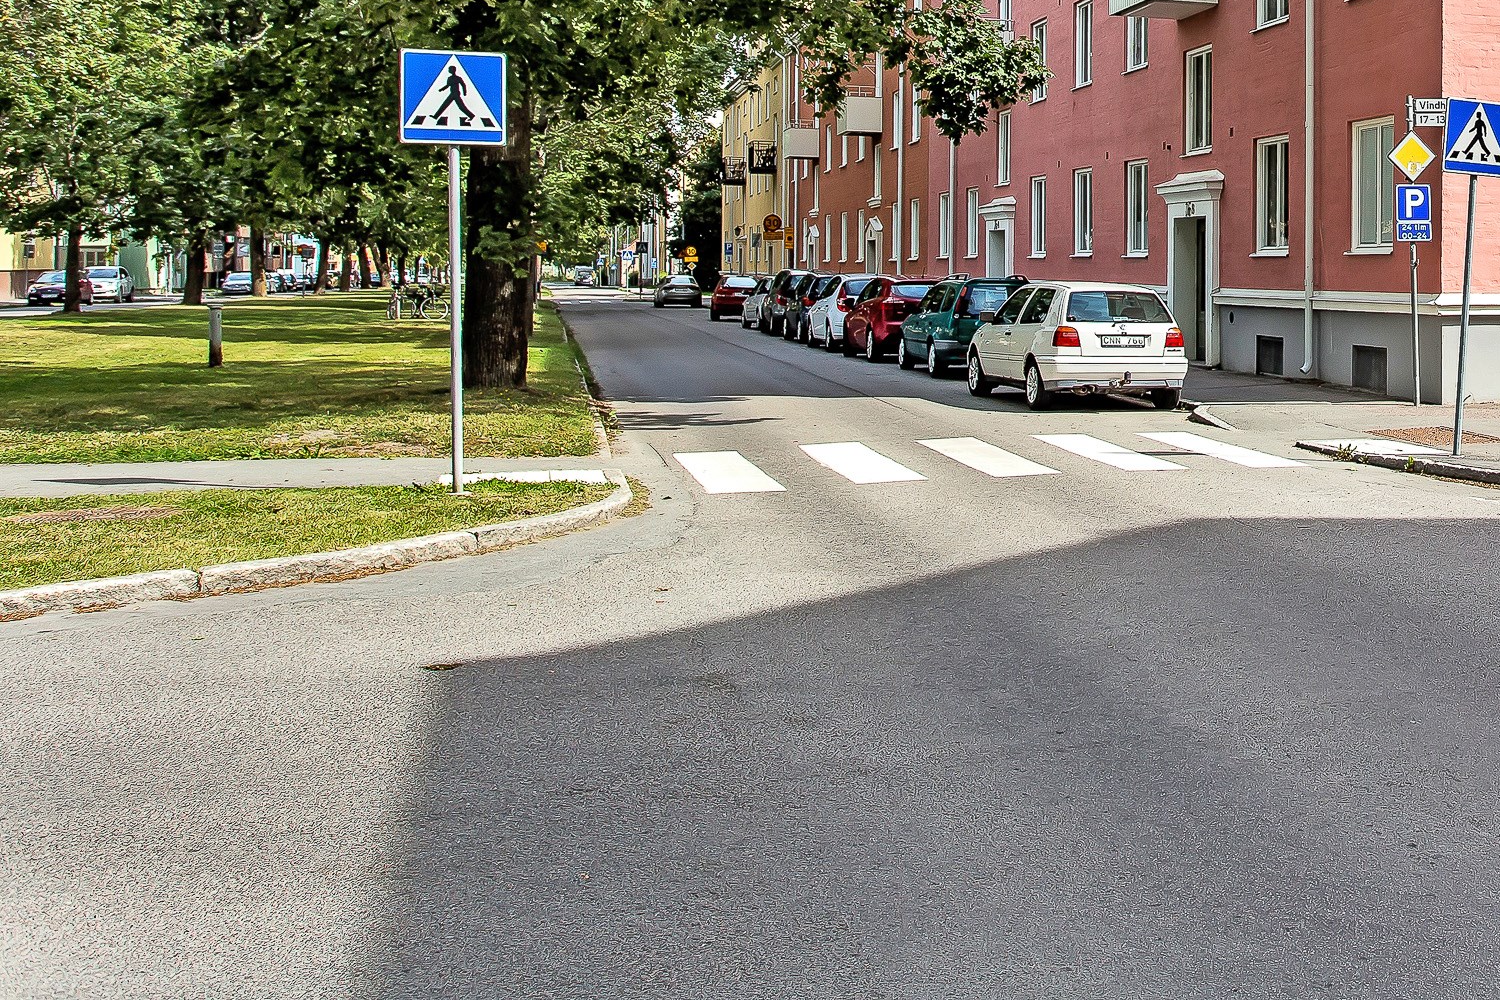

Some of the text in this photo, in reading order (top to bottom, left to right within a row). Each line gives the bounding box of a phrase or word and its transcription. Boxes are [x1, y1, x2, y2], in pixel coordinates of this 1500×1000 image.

[1419, 101, 1446, 110] Vindh
[1405, 188, 1425, 219] P
[766, 218, 779, 227] 30
[1103, 336, 1121, 345] CNN
